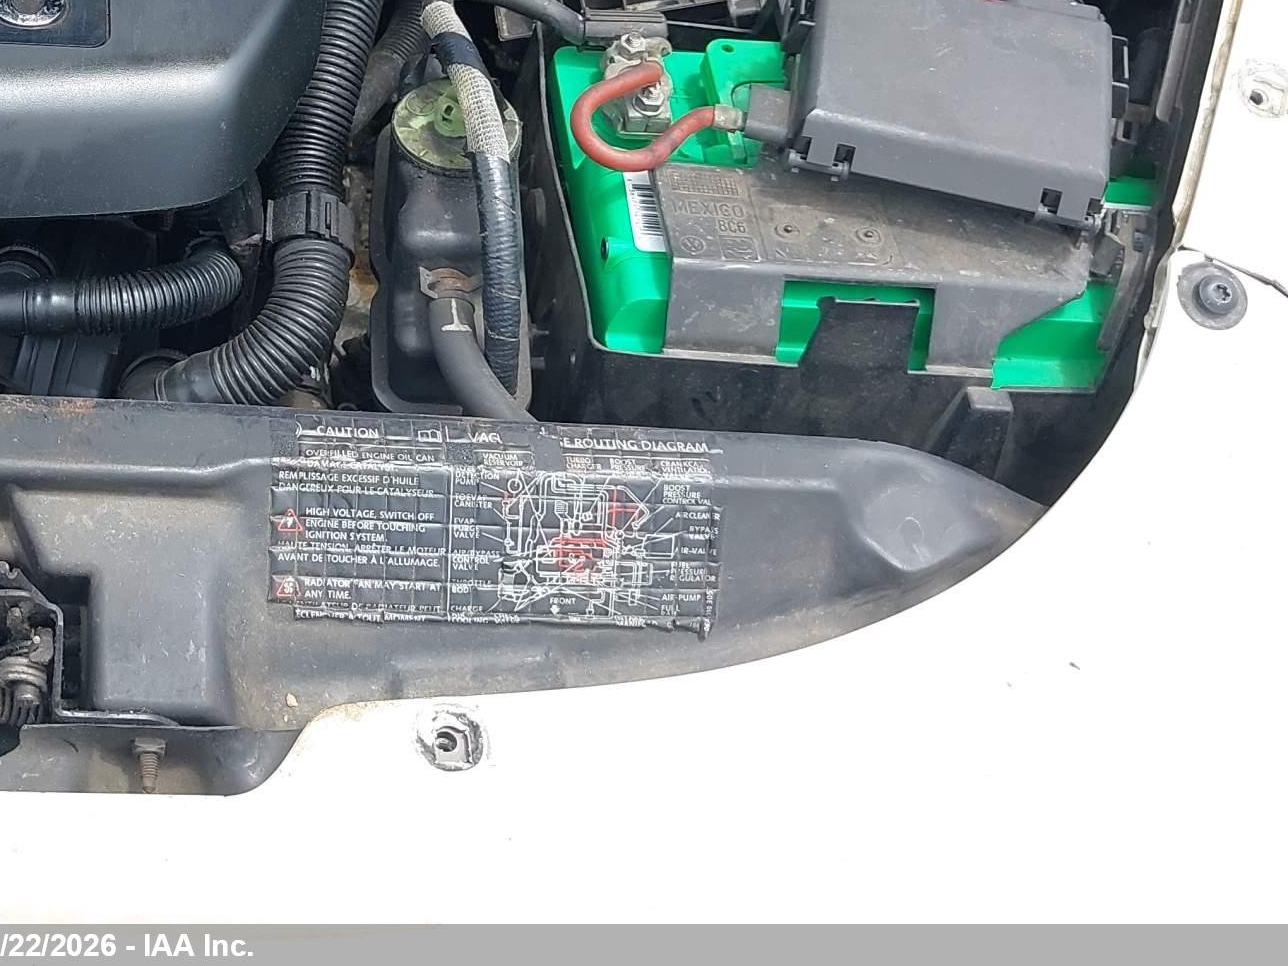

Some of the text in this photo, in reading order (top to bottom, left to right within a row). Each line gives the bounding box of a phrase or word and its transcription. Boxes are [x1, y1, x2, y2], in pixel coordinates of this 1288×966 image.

[317, 425, 379, 438] CAUTION
[572, 438, 638, 450] ROUTING
[642, 440, 709, 452] DIAGRAM
[362, 452, 395, 460] ENGINE
[398, 453, 412, 461] OIL
[416, 454, 434, 462] CAN
[483, 452, 518, 460] VACUUM
[279, 471, 420, 485] REMPLISSAGE EXCESSIF D'HUILE
[278, 482, 333, 492] DANGEREUX
[337, 484, 362, 495] POUR
[365, 486, 375, 495] LE
[663, 491, 701, 499] PRESSURE
[306, 507, 330, 516] HIGH
[379, 510, 414, 520] SWITCH
[418, 512, 434, 521] OFF
[306, 519, 426, 533] ENGINE BEFORE TOUCHING
[306, 530, 388, 542] IGNITION SYSTEM.
[407, 547, 447, 556] MOTEUR
[278, 553, 308, 562] AVANT
[326, 555, 368, 565] TOUCHER
[370, 553, 378, 564] À
[452, 556, 490, 565] CONTROL
[305, 579, 351, 588] RADIATOR
[375, 580, 395, 590] MAY
[398, 581, 425, 591] START
[429, 582, 442, 591] AT
[305, 589, 352, 600] ANY TIME.
